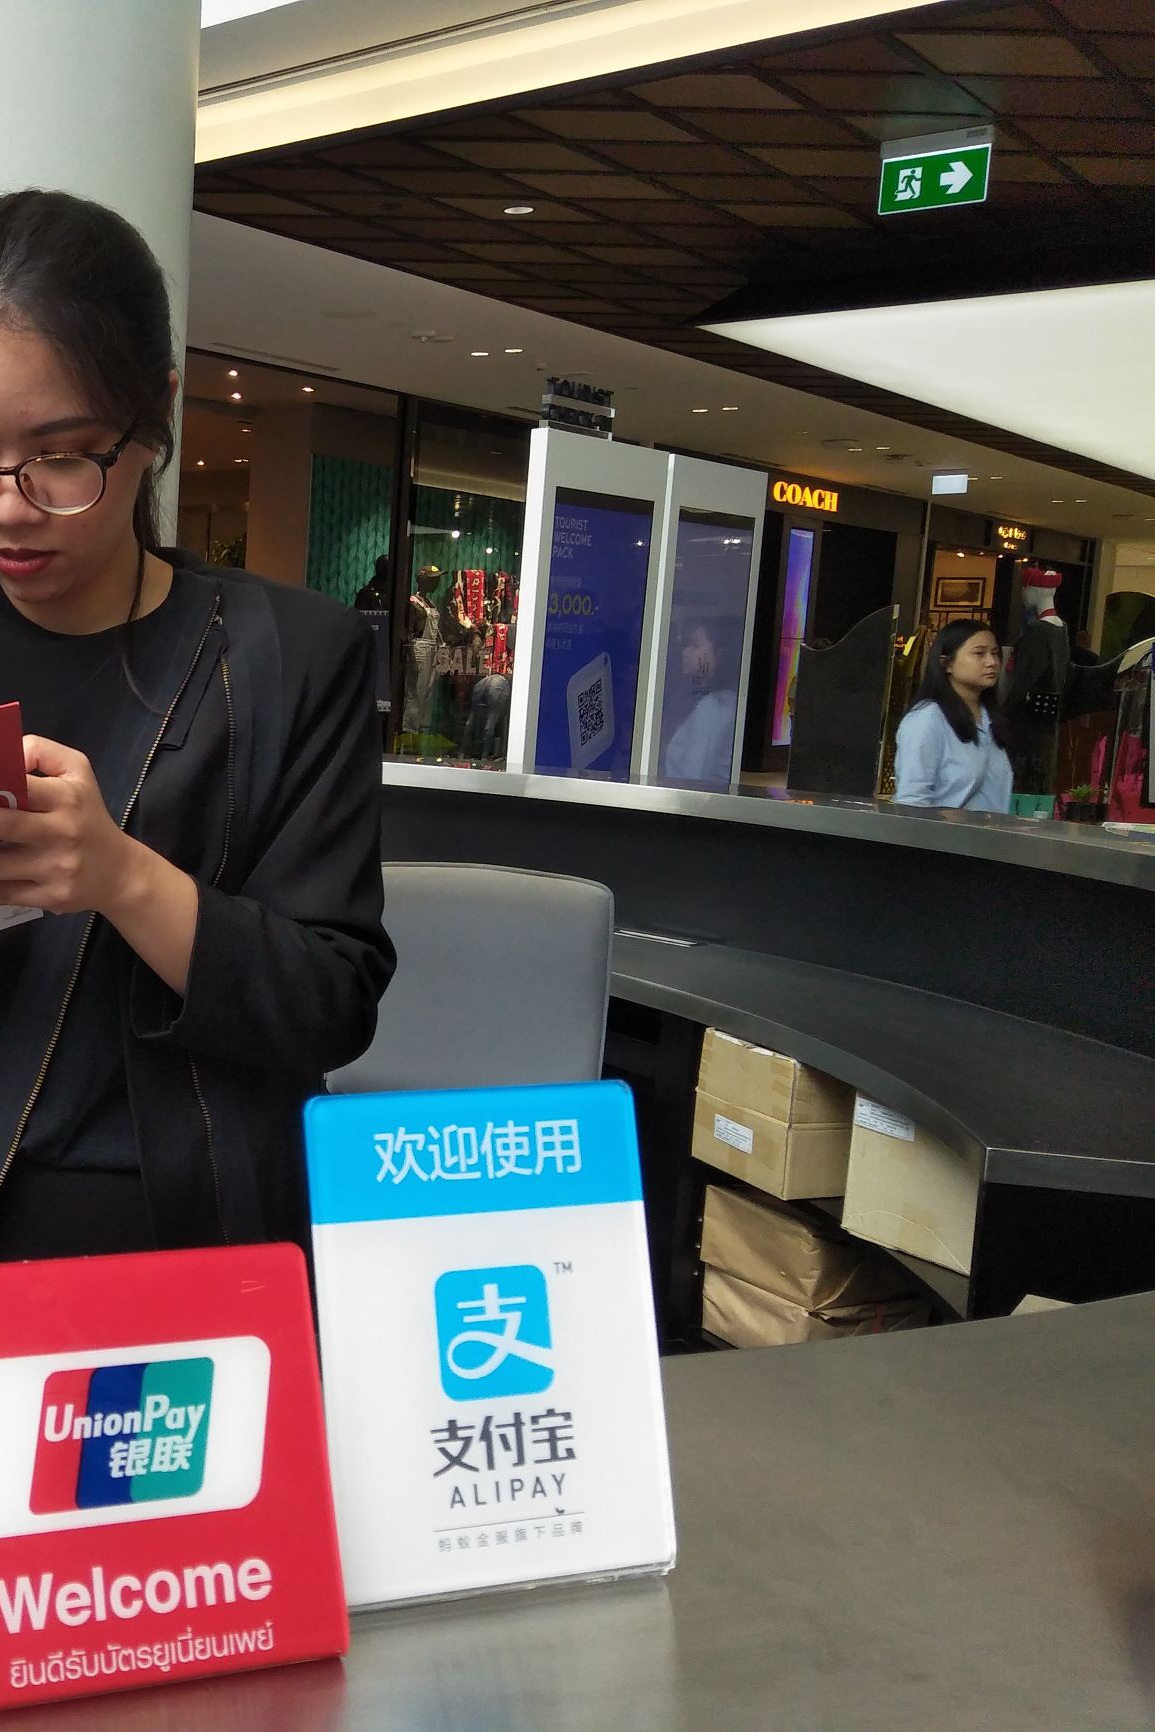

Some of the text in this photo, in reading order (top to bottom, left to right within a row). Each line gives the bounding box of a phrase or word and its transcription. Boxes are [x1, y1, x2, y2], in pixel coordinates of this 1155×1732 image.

[773, 481, 839, 512] COACH
[553, 530, 592, 546] WELCOME
[554, 516, 588, 531] TOURIST
[552, 546, 574, 559] PACK
[372, 1119, 582, 1185] 欢迎使用
[44, 1394, 206, 1443] UnionPay
[108, 1436, 192, 1478] 银联
[431, 1408, 578, 1478] 支付宝
[450, 1473, 567, 1509] ALIPAY
[10, 1620, 275, 1689] ยินดีรับบัตรยูเนี่ยนเพย์
